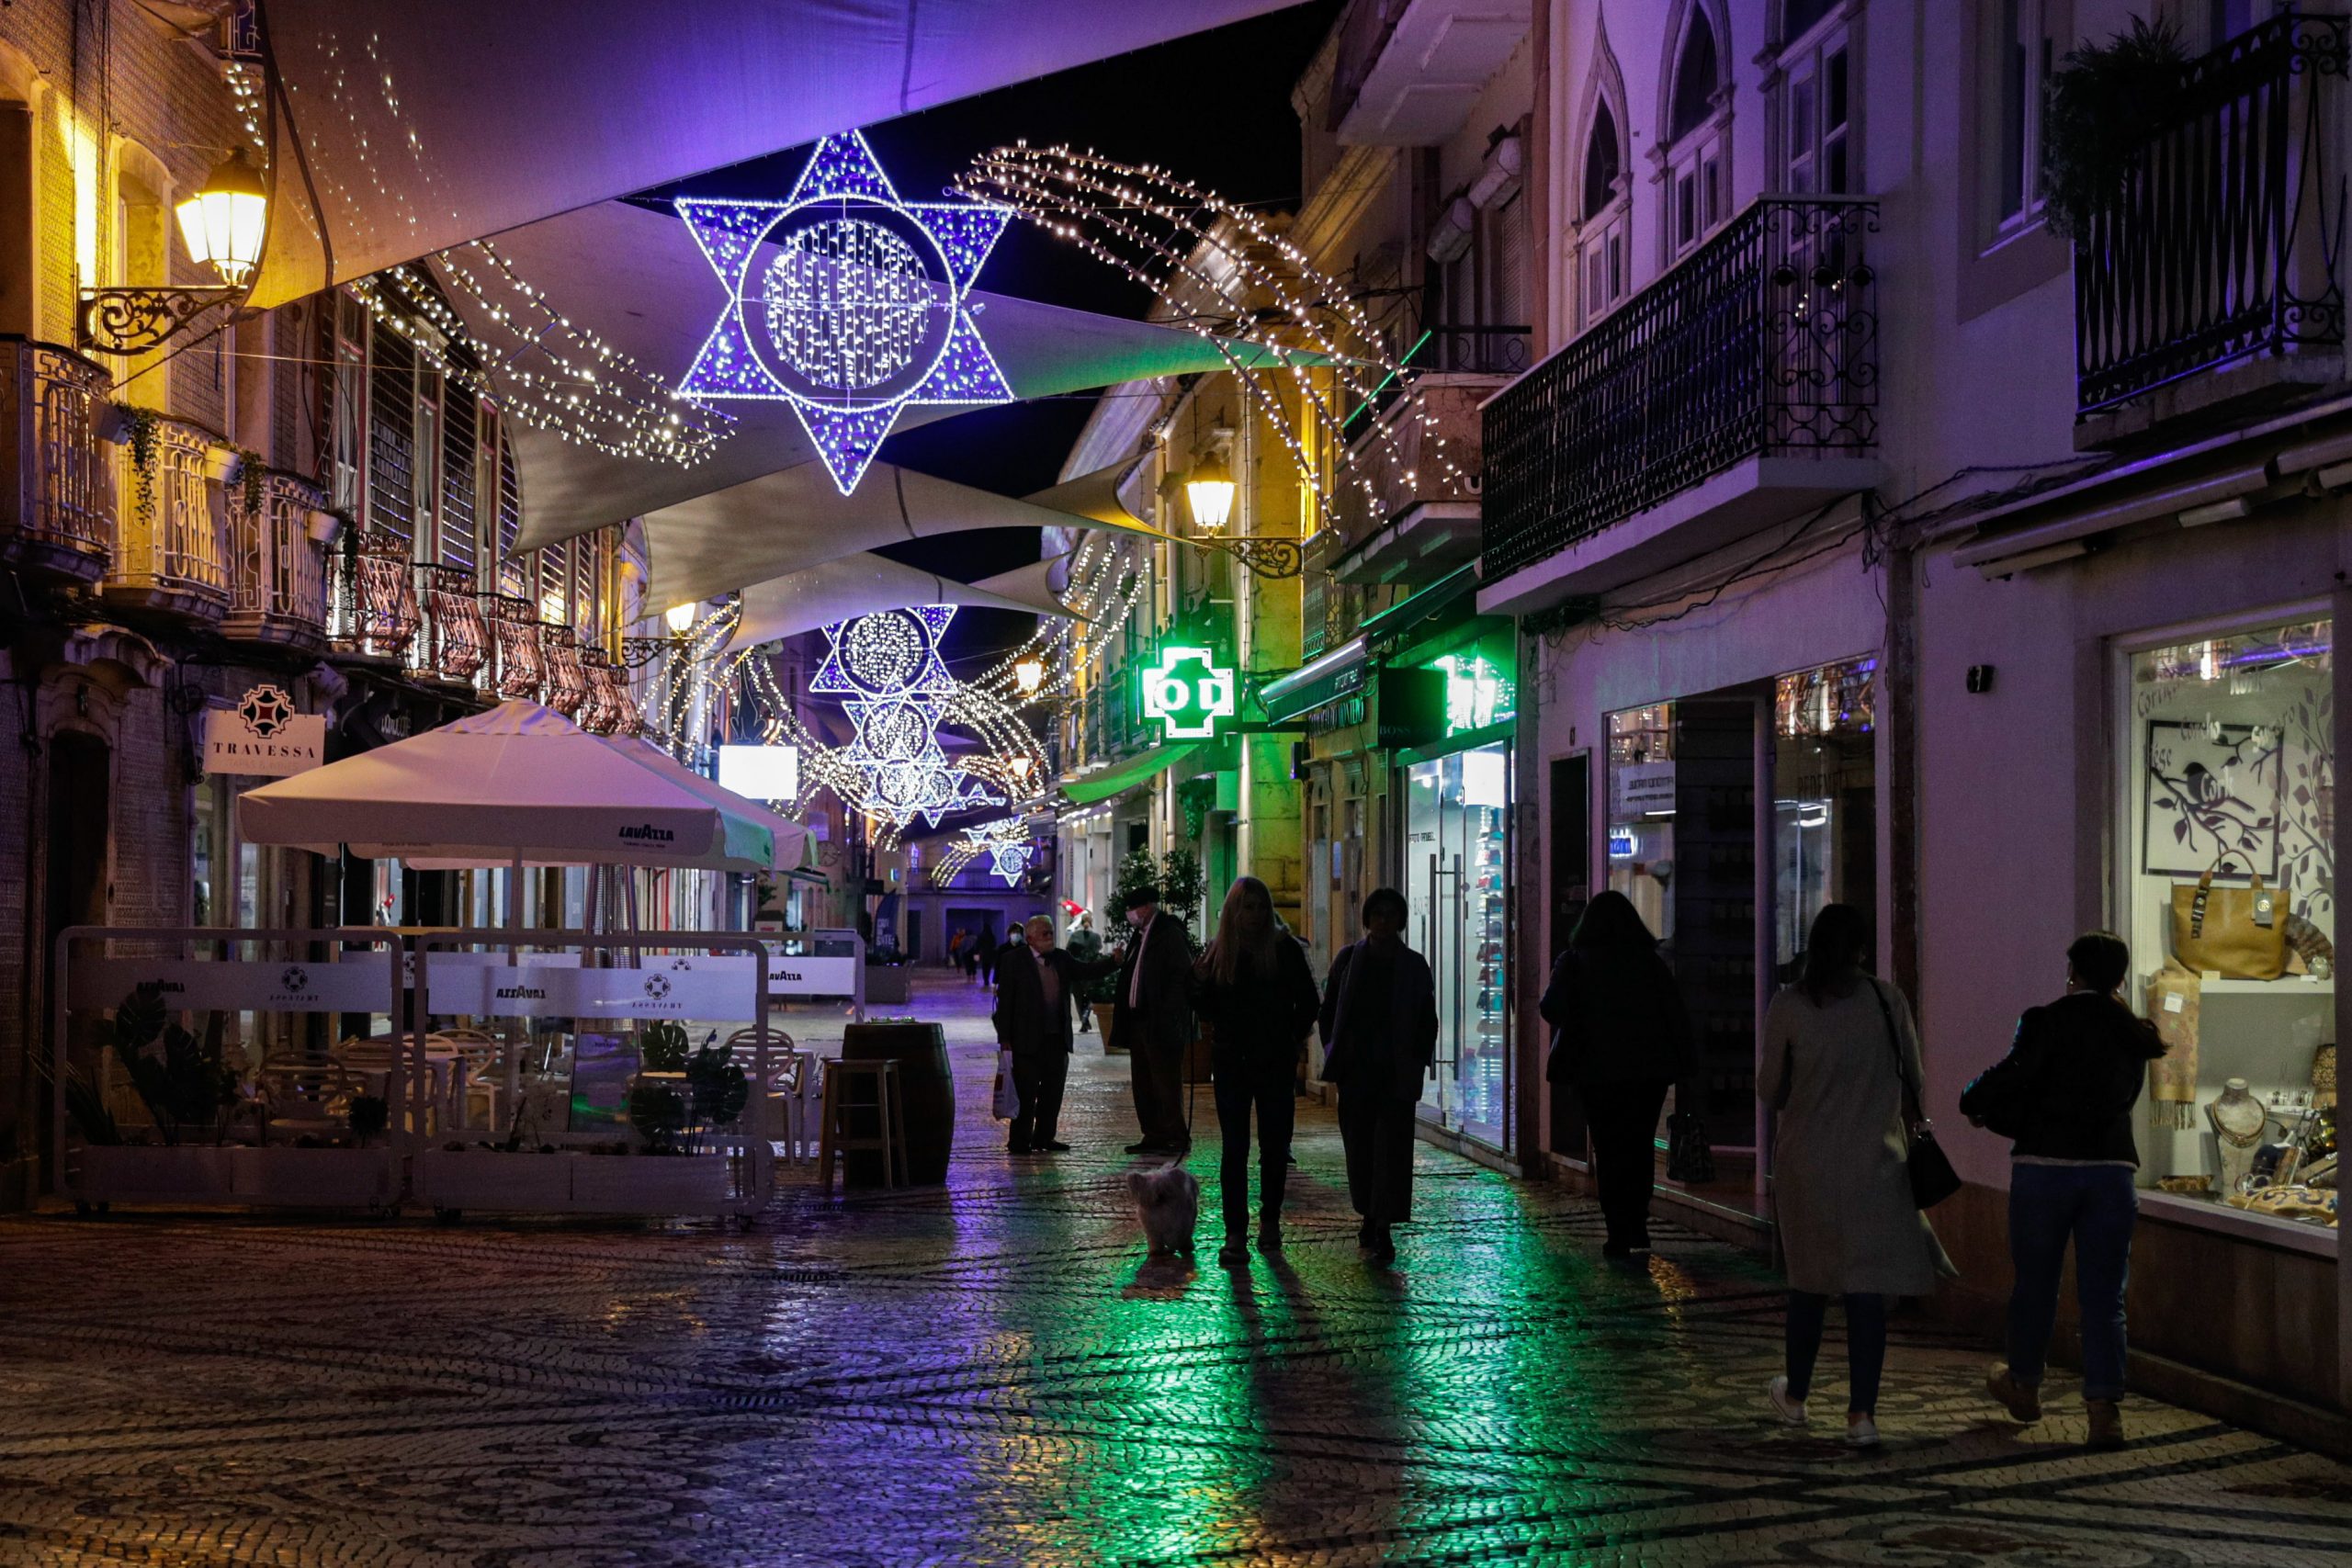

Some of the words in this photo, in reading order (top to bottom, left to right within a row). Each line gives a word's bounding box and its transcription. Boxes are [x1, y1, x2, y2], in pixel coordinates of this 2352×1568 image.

[1379, 726, 1411, 736] BOSS
[213, 741, 315, 759] TRAVESSA
[618, 824, 674, 841] LAVAZZA
[769, 971, 802, 981] AVAZZA
